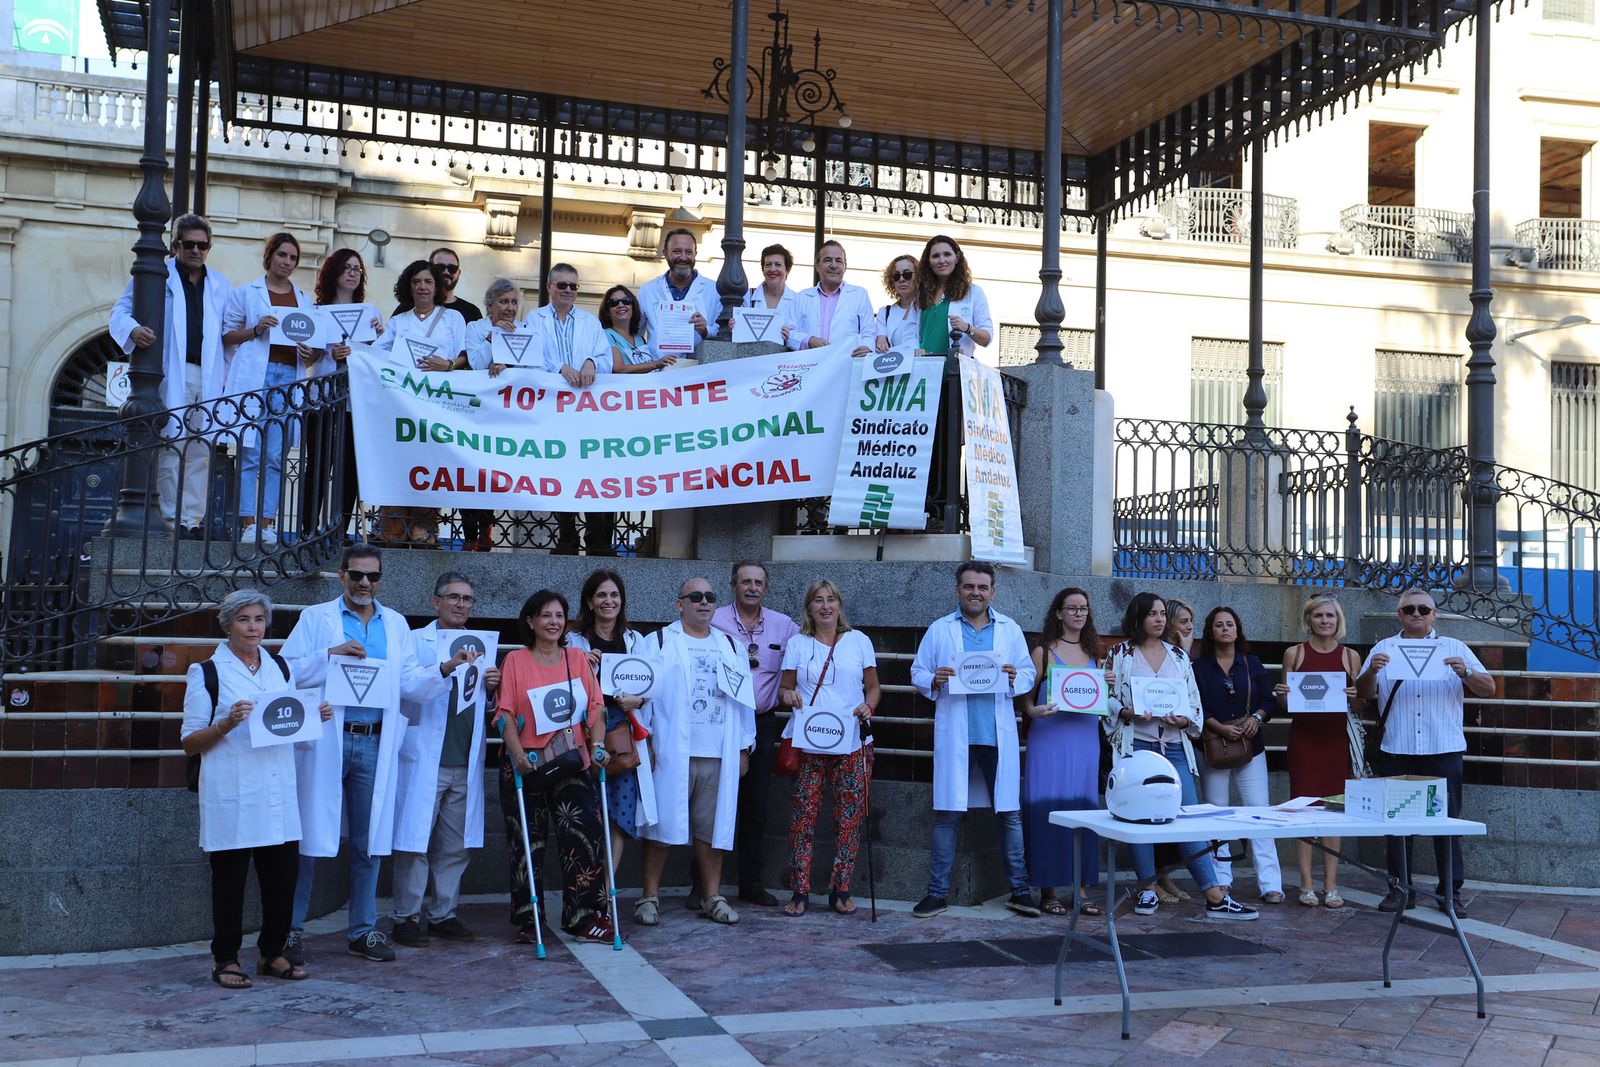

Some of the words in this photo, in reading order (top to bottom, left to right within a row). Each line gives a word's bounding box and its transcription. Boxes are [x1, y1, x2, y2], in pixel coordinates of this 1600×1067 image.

[291, 319, 307, 330] NO
[881, 356, 897, 364] NO
[556, 379, 728, 413] PACIENTE
[860, 373, 927, 412] SMA
[968, 378, 1002, 420] SMA
[395, 417, 566, 459] DIGNIDAD
[580, 410, 824, 459] PROFESIONAL
[851, 418, 929, 436] Sindicato
[967, 420, 1008, 444] Sindicato
[857, 440, 917, 457] Médico
[974, 443, 1006, 464] Médico
[409, 465, 562, 497] CALIDAD
[574, 458, 811, 499] ASISTENCIAL
[850, 461, 917, 479] Andaluz
[975, 466, 1011, 488] Andaluz
[614, 673, 653, 681] AGRESION
[553, 696, 566, 708] 10
[276, 706, 293, 719] 10
[271, 721, 299, 730] MINUTOS
[806, 725, 844, 736] AGRESION
